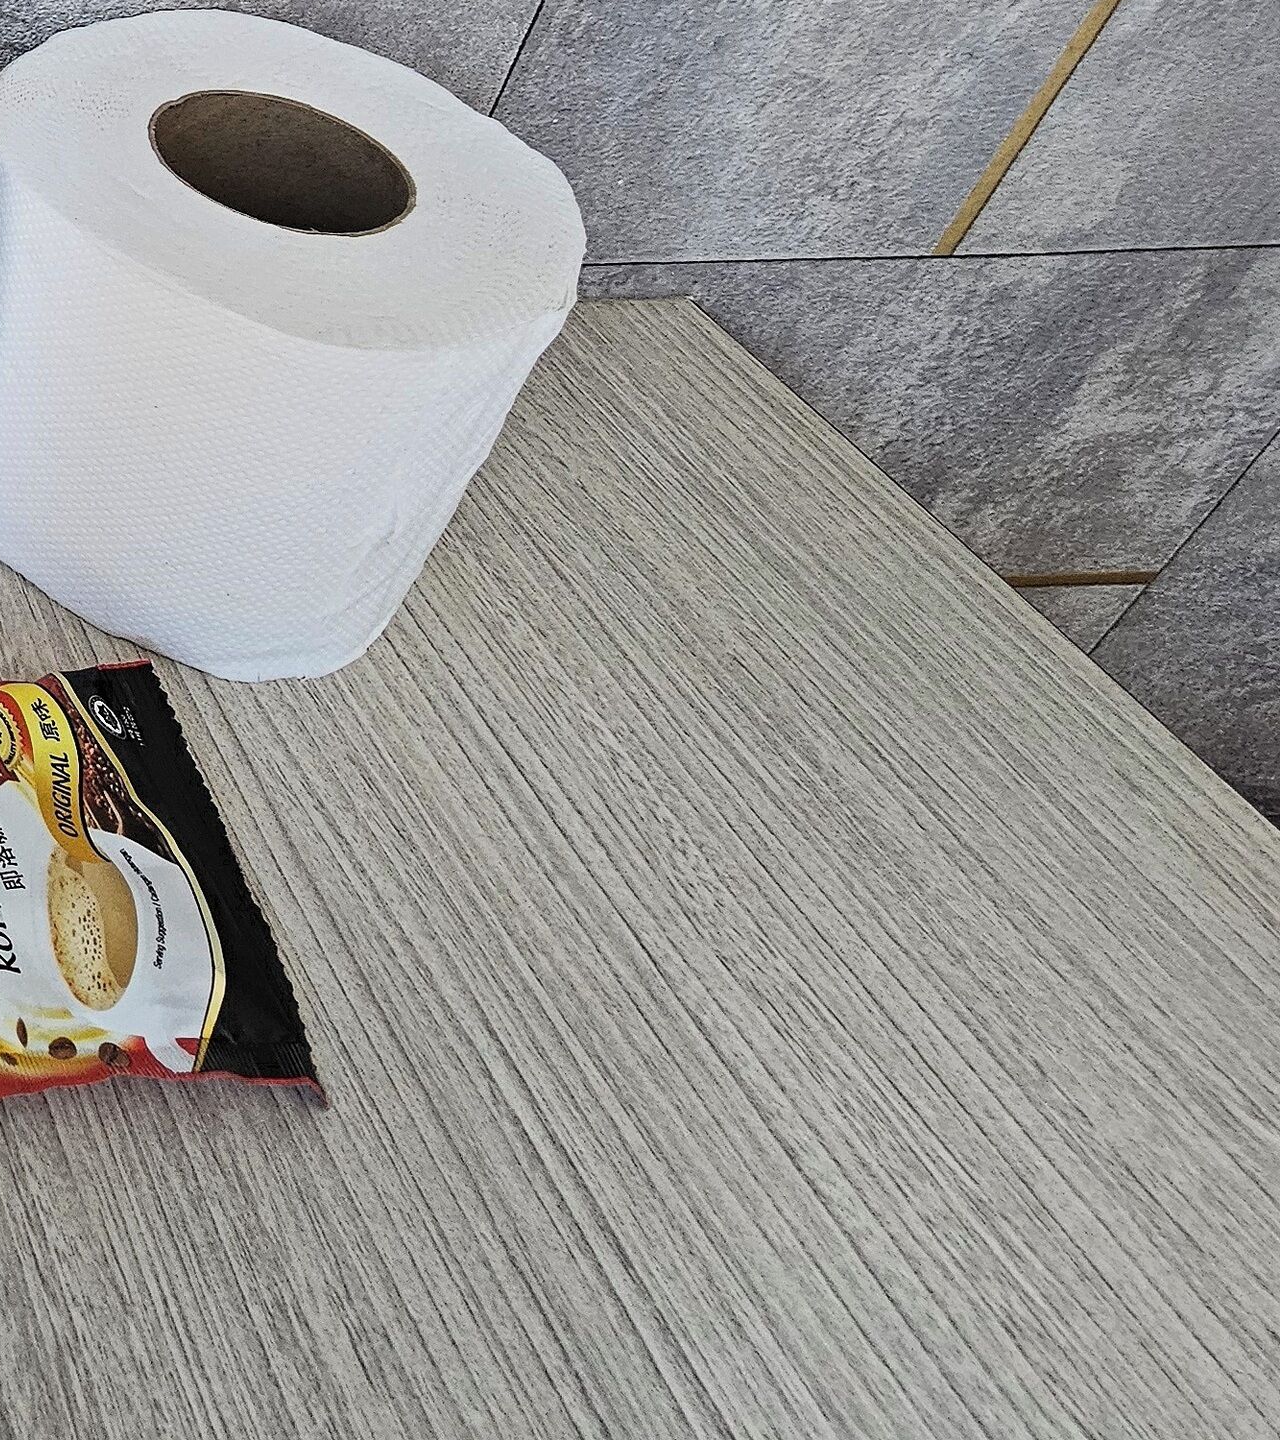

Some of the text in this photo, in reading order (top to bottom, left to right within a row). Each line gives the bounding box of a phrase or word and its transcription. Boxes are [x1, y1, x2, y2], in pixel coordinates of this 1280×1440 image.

[30, 697, 61, 742] 原味
[48, 752, 79, 839] ORIGINAL
[155, 907, 167, 945] Suggestion
[153, 944, 166, 970] Serving
